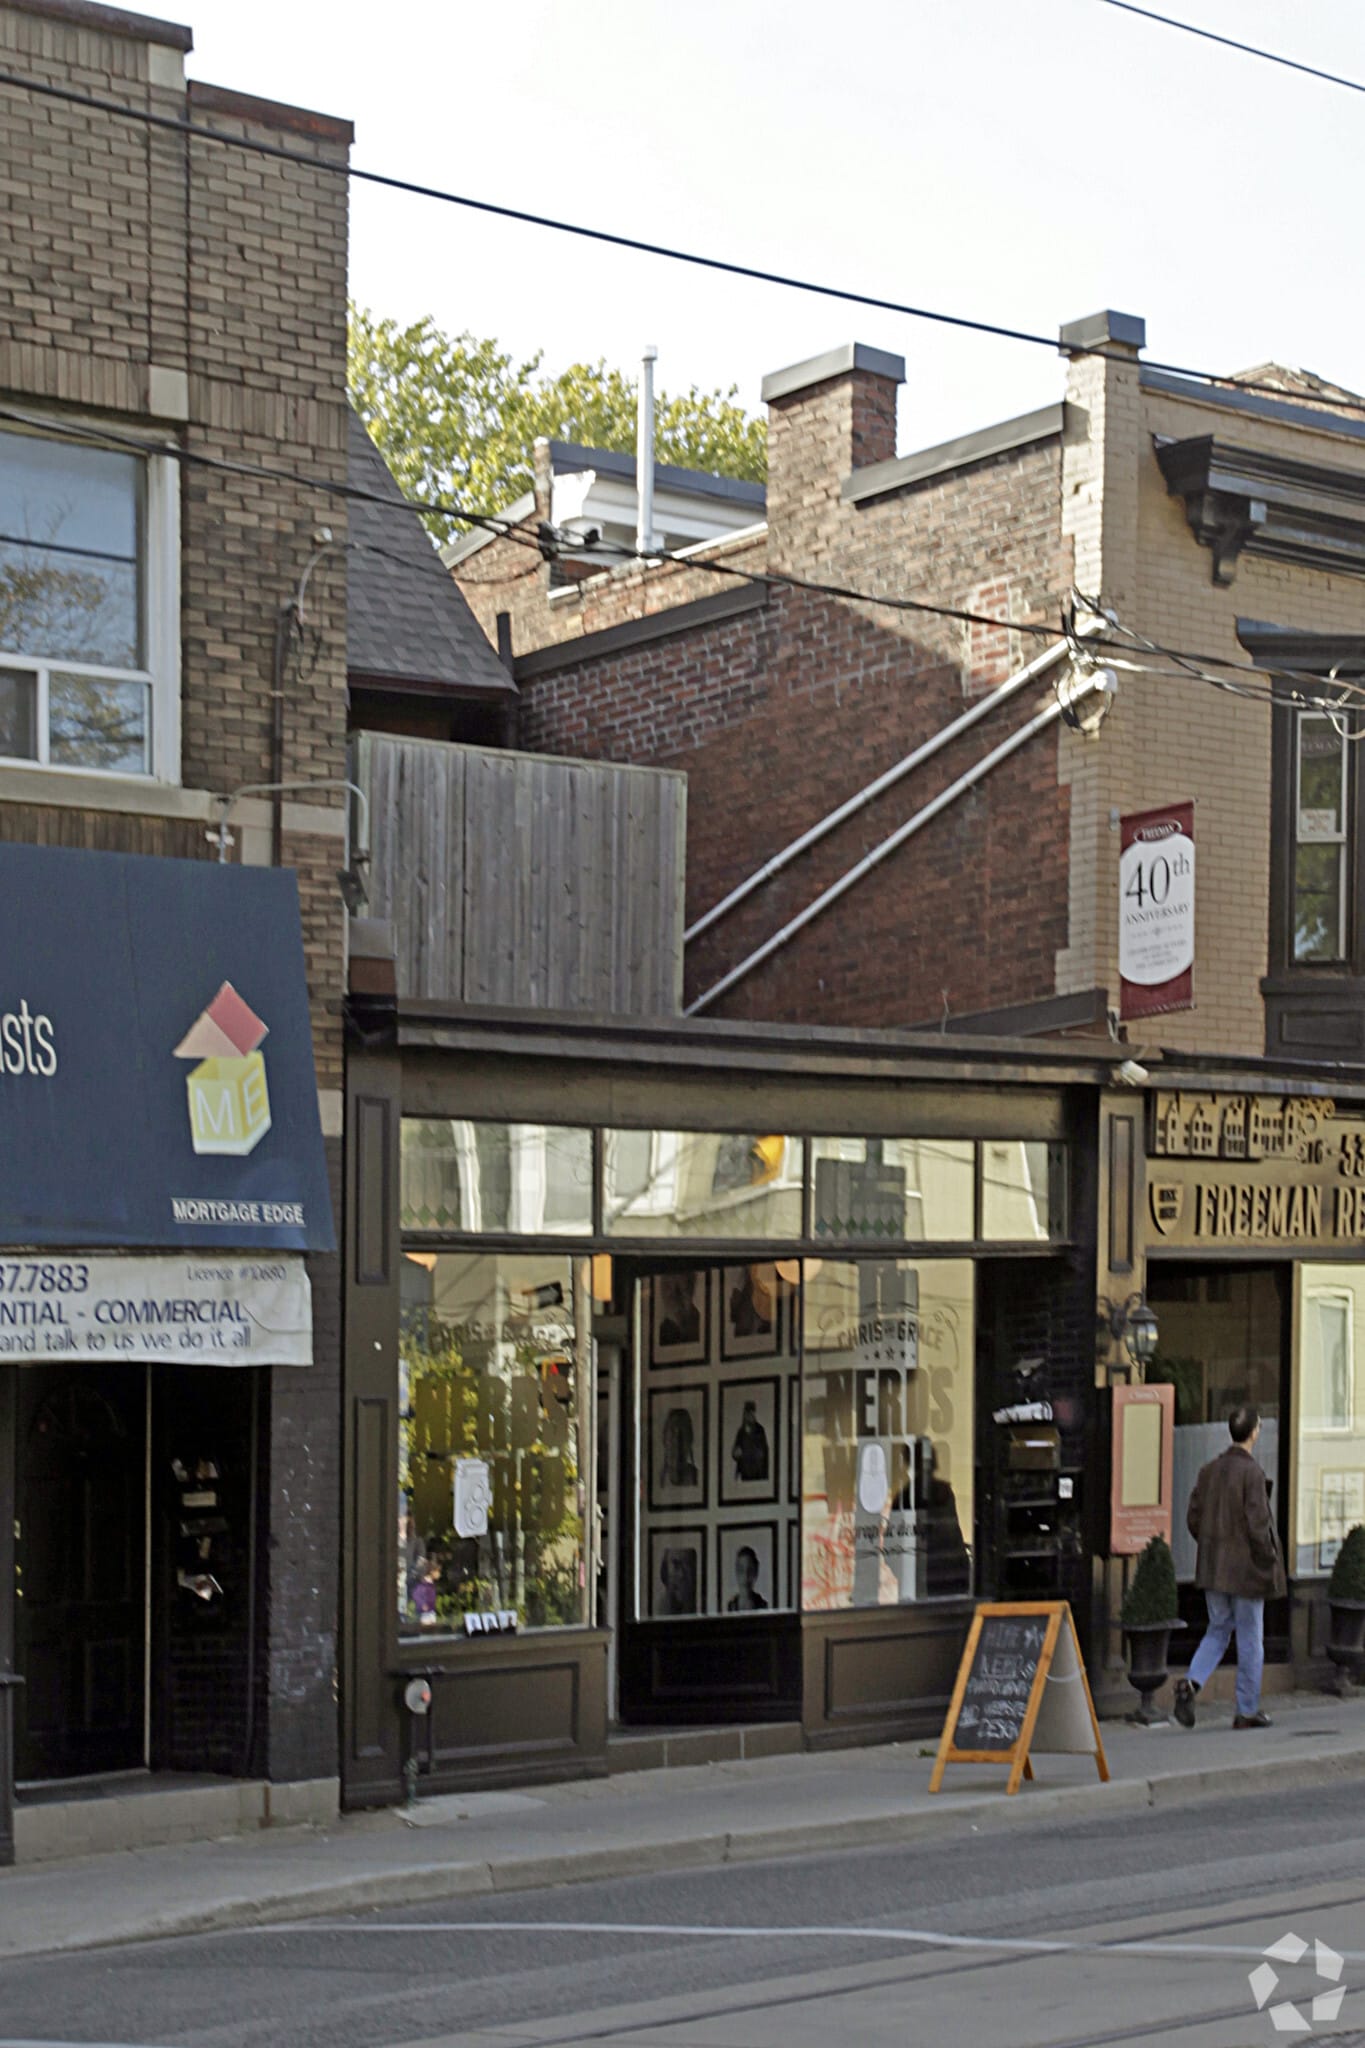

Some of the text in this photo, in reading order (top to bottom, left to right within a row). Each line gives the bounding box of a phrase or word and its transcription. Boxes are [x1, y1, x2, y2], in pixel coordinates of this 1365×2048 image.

[1125, 852, 1190, 908] 40th
[1125, 903, 1190, 926] ANNIVERSARY
[172, 1200, 304, 1225] MORTGAGE EDGE
[1196, 1184, 1322, 1238] FREEMAN
[0, 1299, 70, 1326] NTIAL
[94, 1299, 249, 1325] COMMERCIAL
[0, 1326, 251, 1352] and talk to us we do it all
[837, 1319, 882, 1348] CHRIS
[897, 1319, 945, 1351] GRACE
